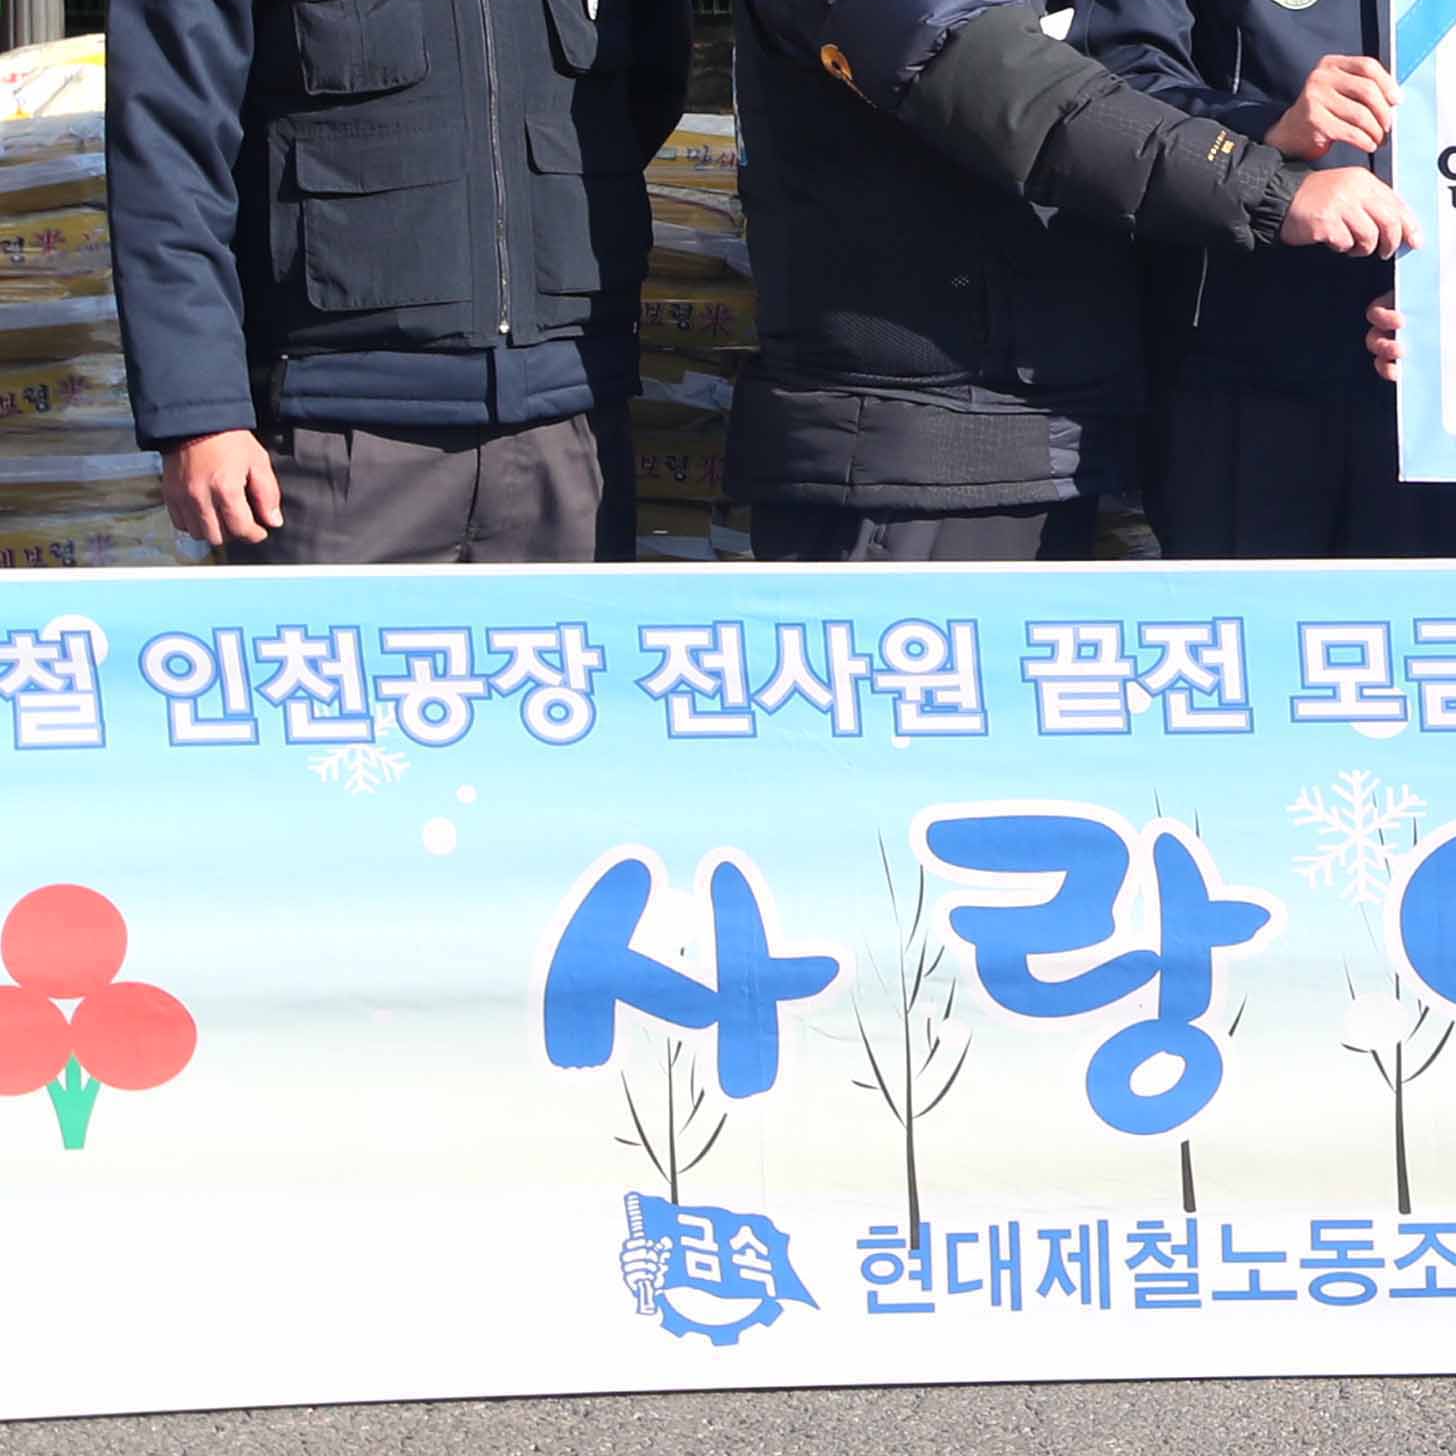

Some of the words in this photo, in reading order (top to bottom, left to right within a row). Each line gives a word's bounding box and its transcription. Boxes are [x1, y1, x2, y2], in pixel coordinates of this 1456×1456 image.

[0, 628, 106, 750] 철
[137, 620, 608, 748] 인천공장
[635, 617, 989, 740] 전사원
[1020, 615, 1254, 737] 끝전
[678, 1213, 776, 1297] 금속
